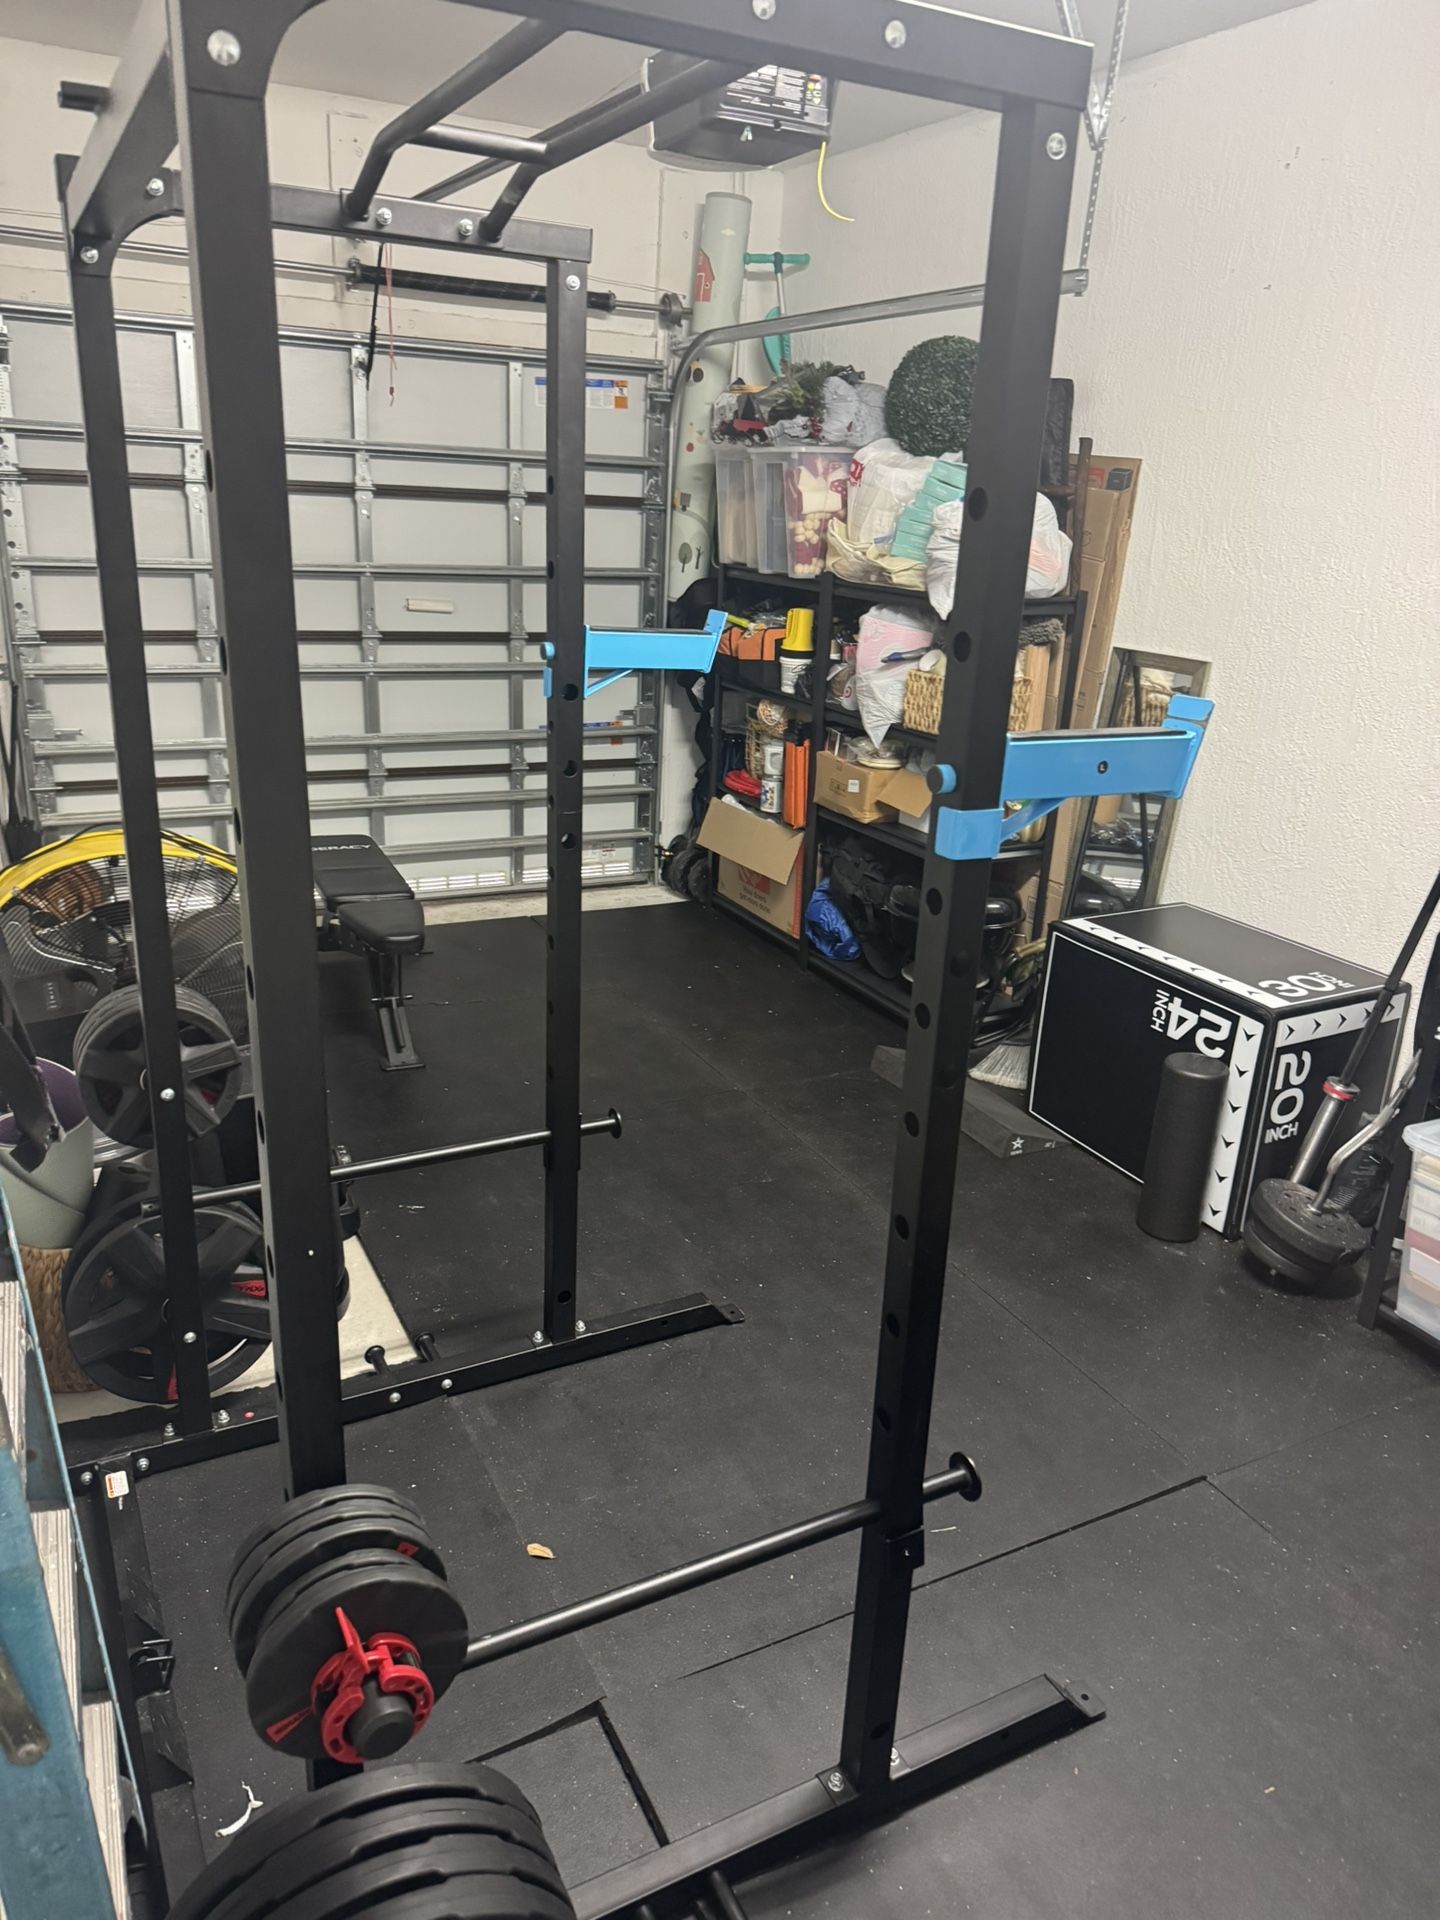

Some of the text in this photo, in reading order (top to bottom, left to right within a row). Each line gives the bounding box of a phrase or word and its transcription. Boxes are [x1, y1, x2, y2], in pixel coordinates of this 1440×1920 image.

[1258, 975, 1336, 997] 30
[1150, 989, 1170, 1032] INCH
[1167, 996, 1232, 1058] 24
[1270, 1050, 1311, 1124] 20
[1264, 1121, 1299, 1144] INCH
